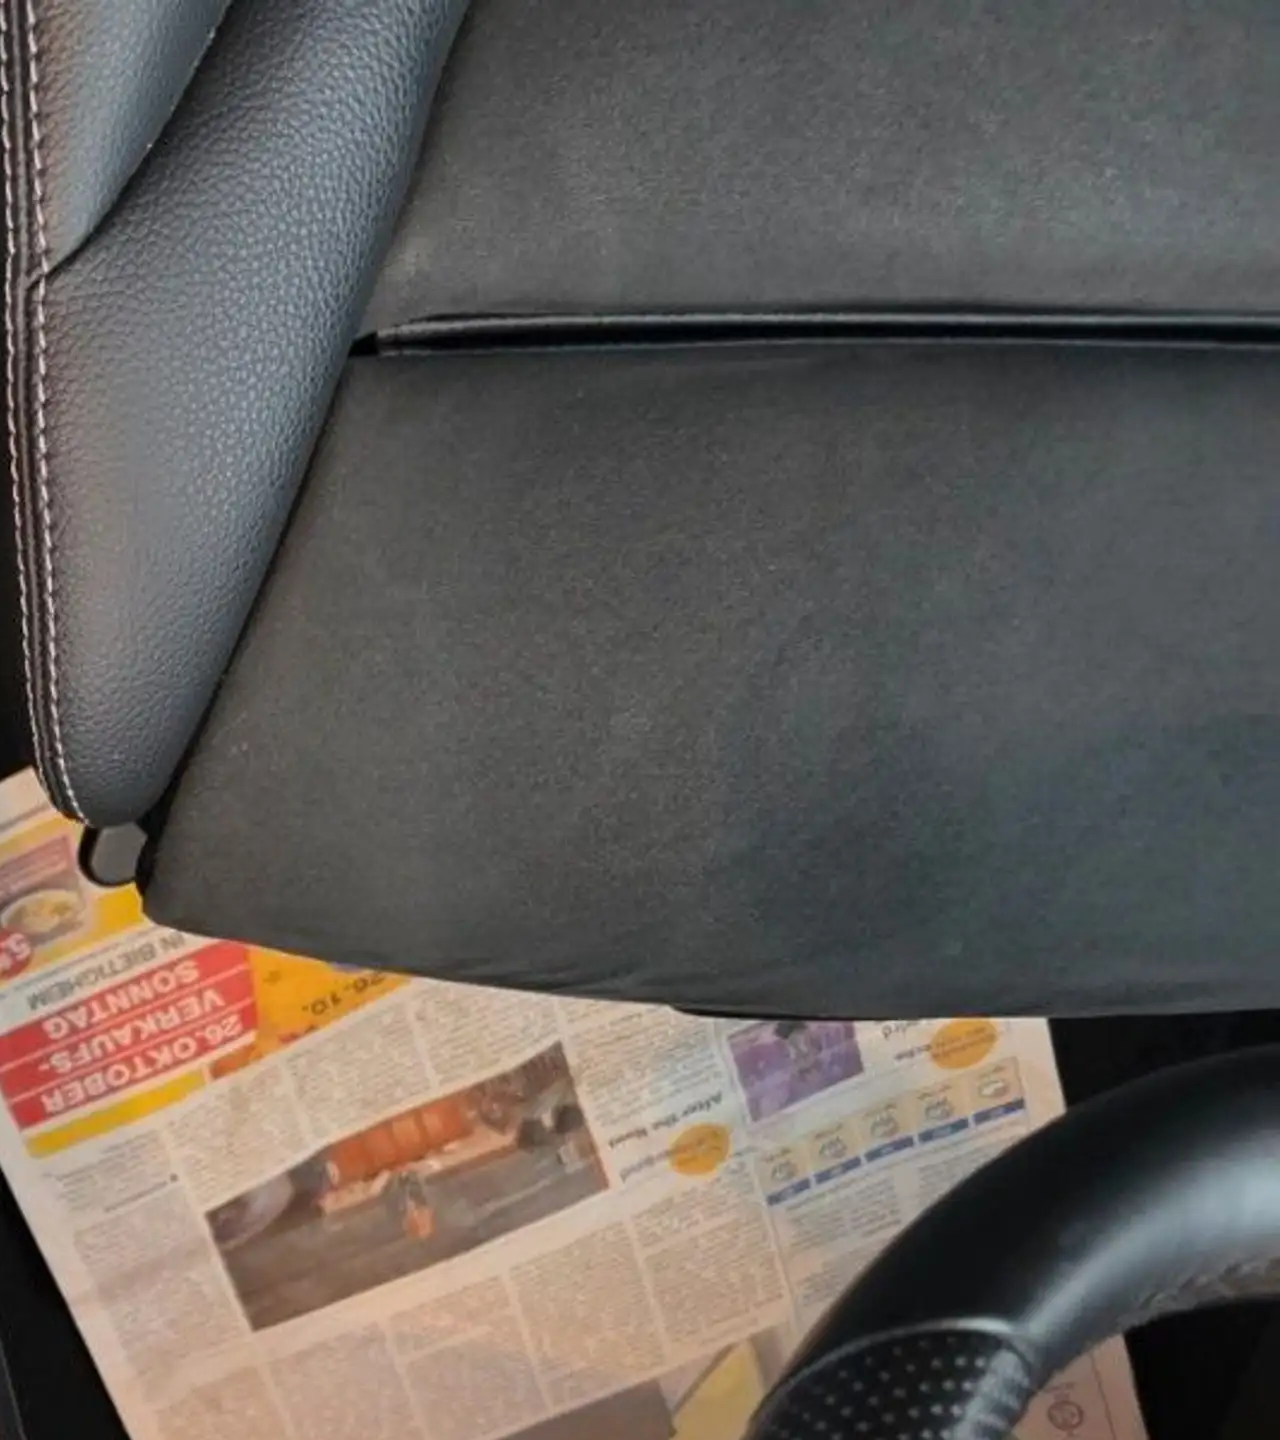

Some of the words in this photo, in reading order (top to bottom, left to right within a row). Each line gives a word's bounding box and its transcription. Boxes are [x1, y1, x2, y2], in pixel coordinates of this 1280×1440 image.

[27, 942, 157, 1011] BIETIGHEIM
[158, 933, 184, 953] IN
[38, 988, 226, 1074] VERKAUFS-
[41, 959, 200, 1040] SONNTAG
